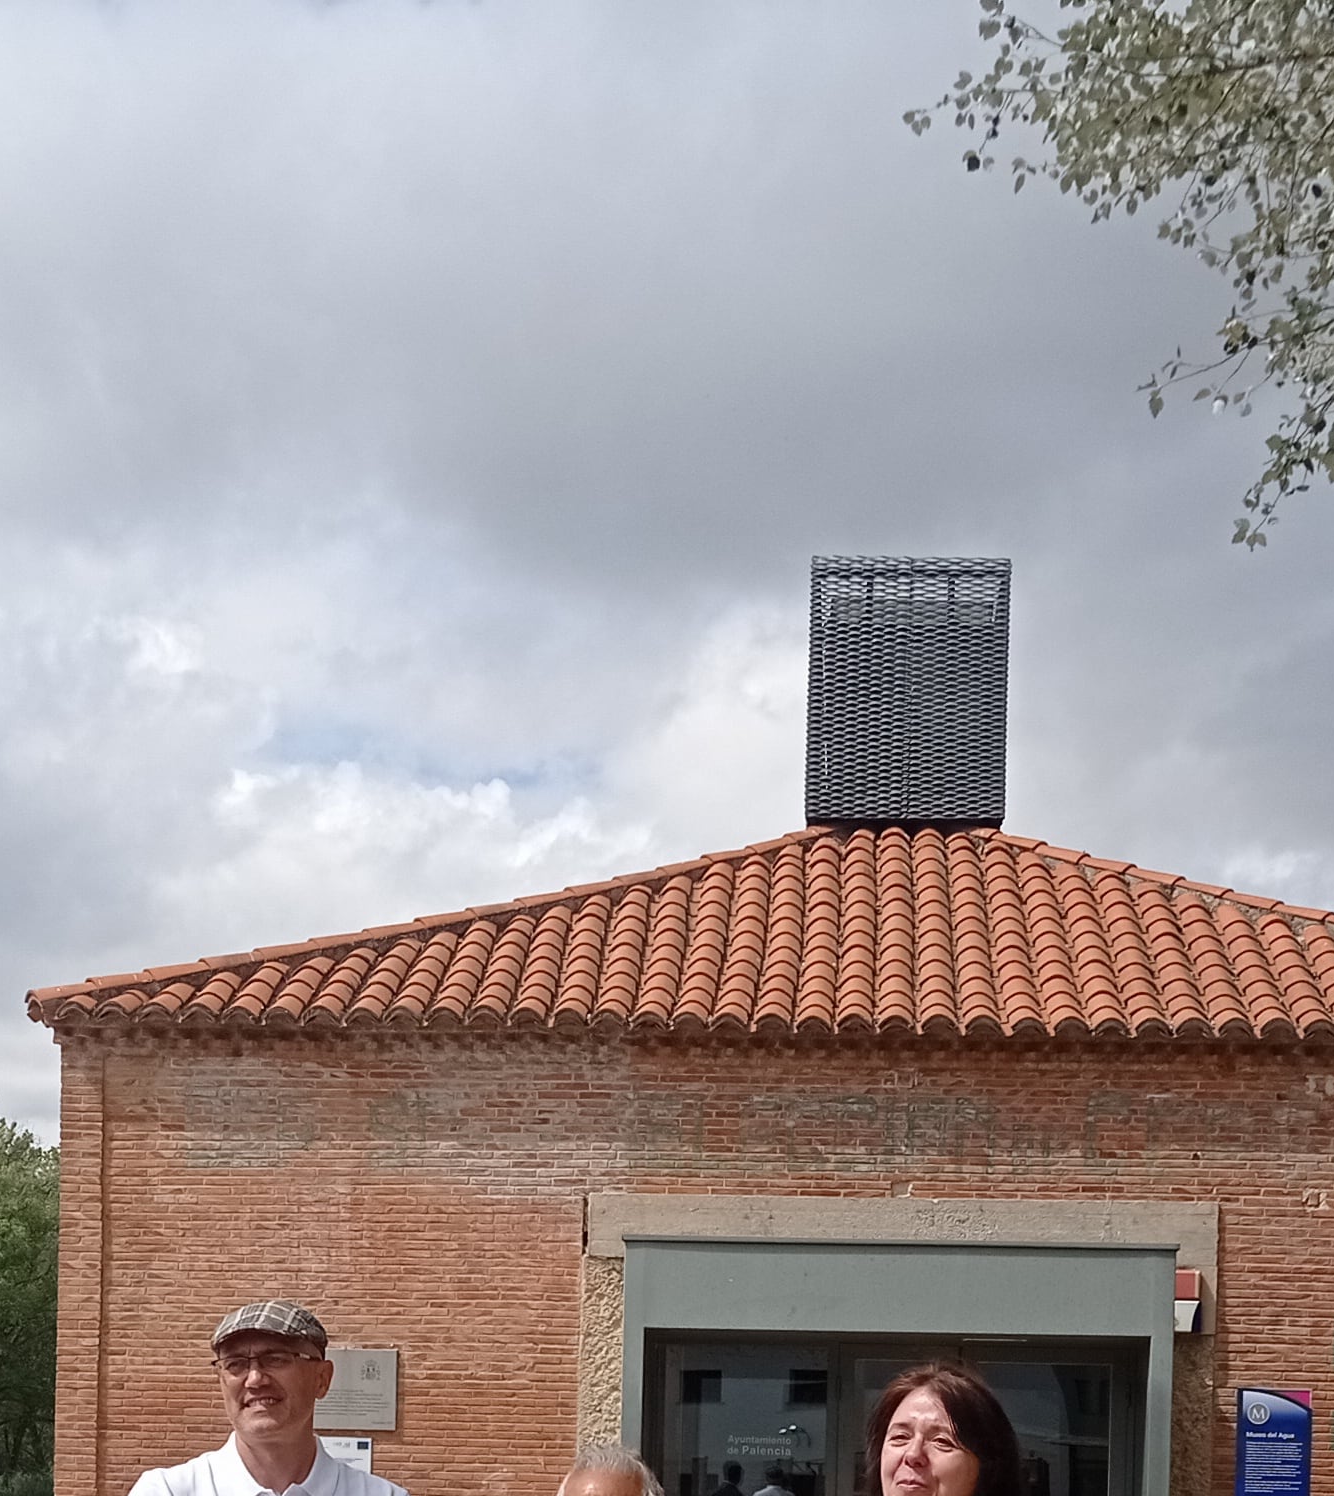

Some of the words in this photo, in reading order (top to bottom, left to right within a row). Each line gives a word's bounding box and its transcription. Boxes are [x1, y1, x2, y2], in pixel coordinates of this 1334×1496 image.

[1252, 1408, 1265, 1419] M
[727, 1434, 792, 1446] Ayuntamiento
[727, 1446, 739, 1455] de
[742, 1445, 792, 1456] Palencia
